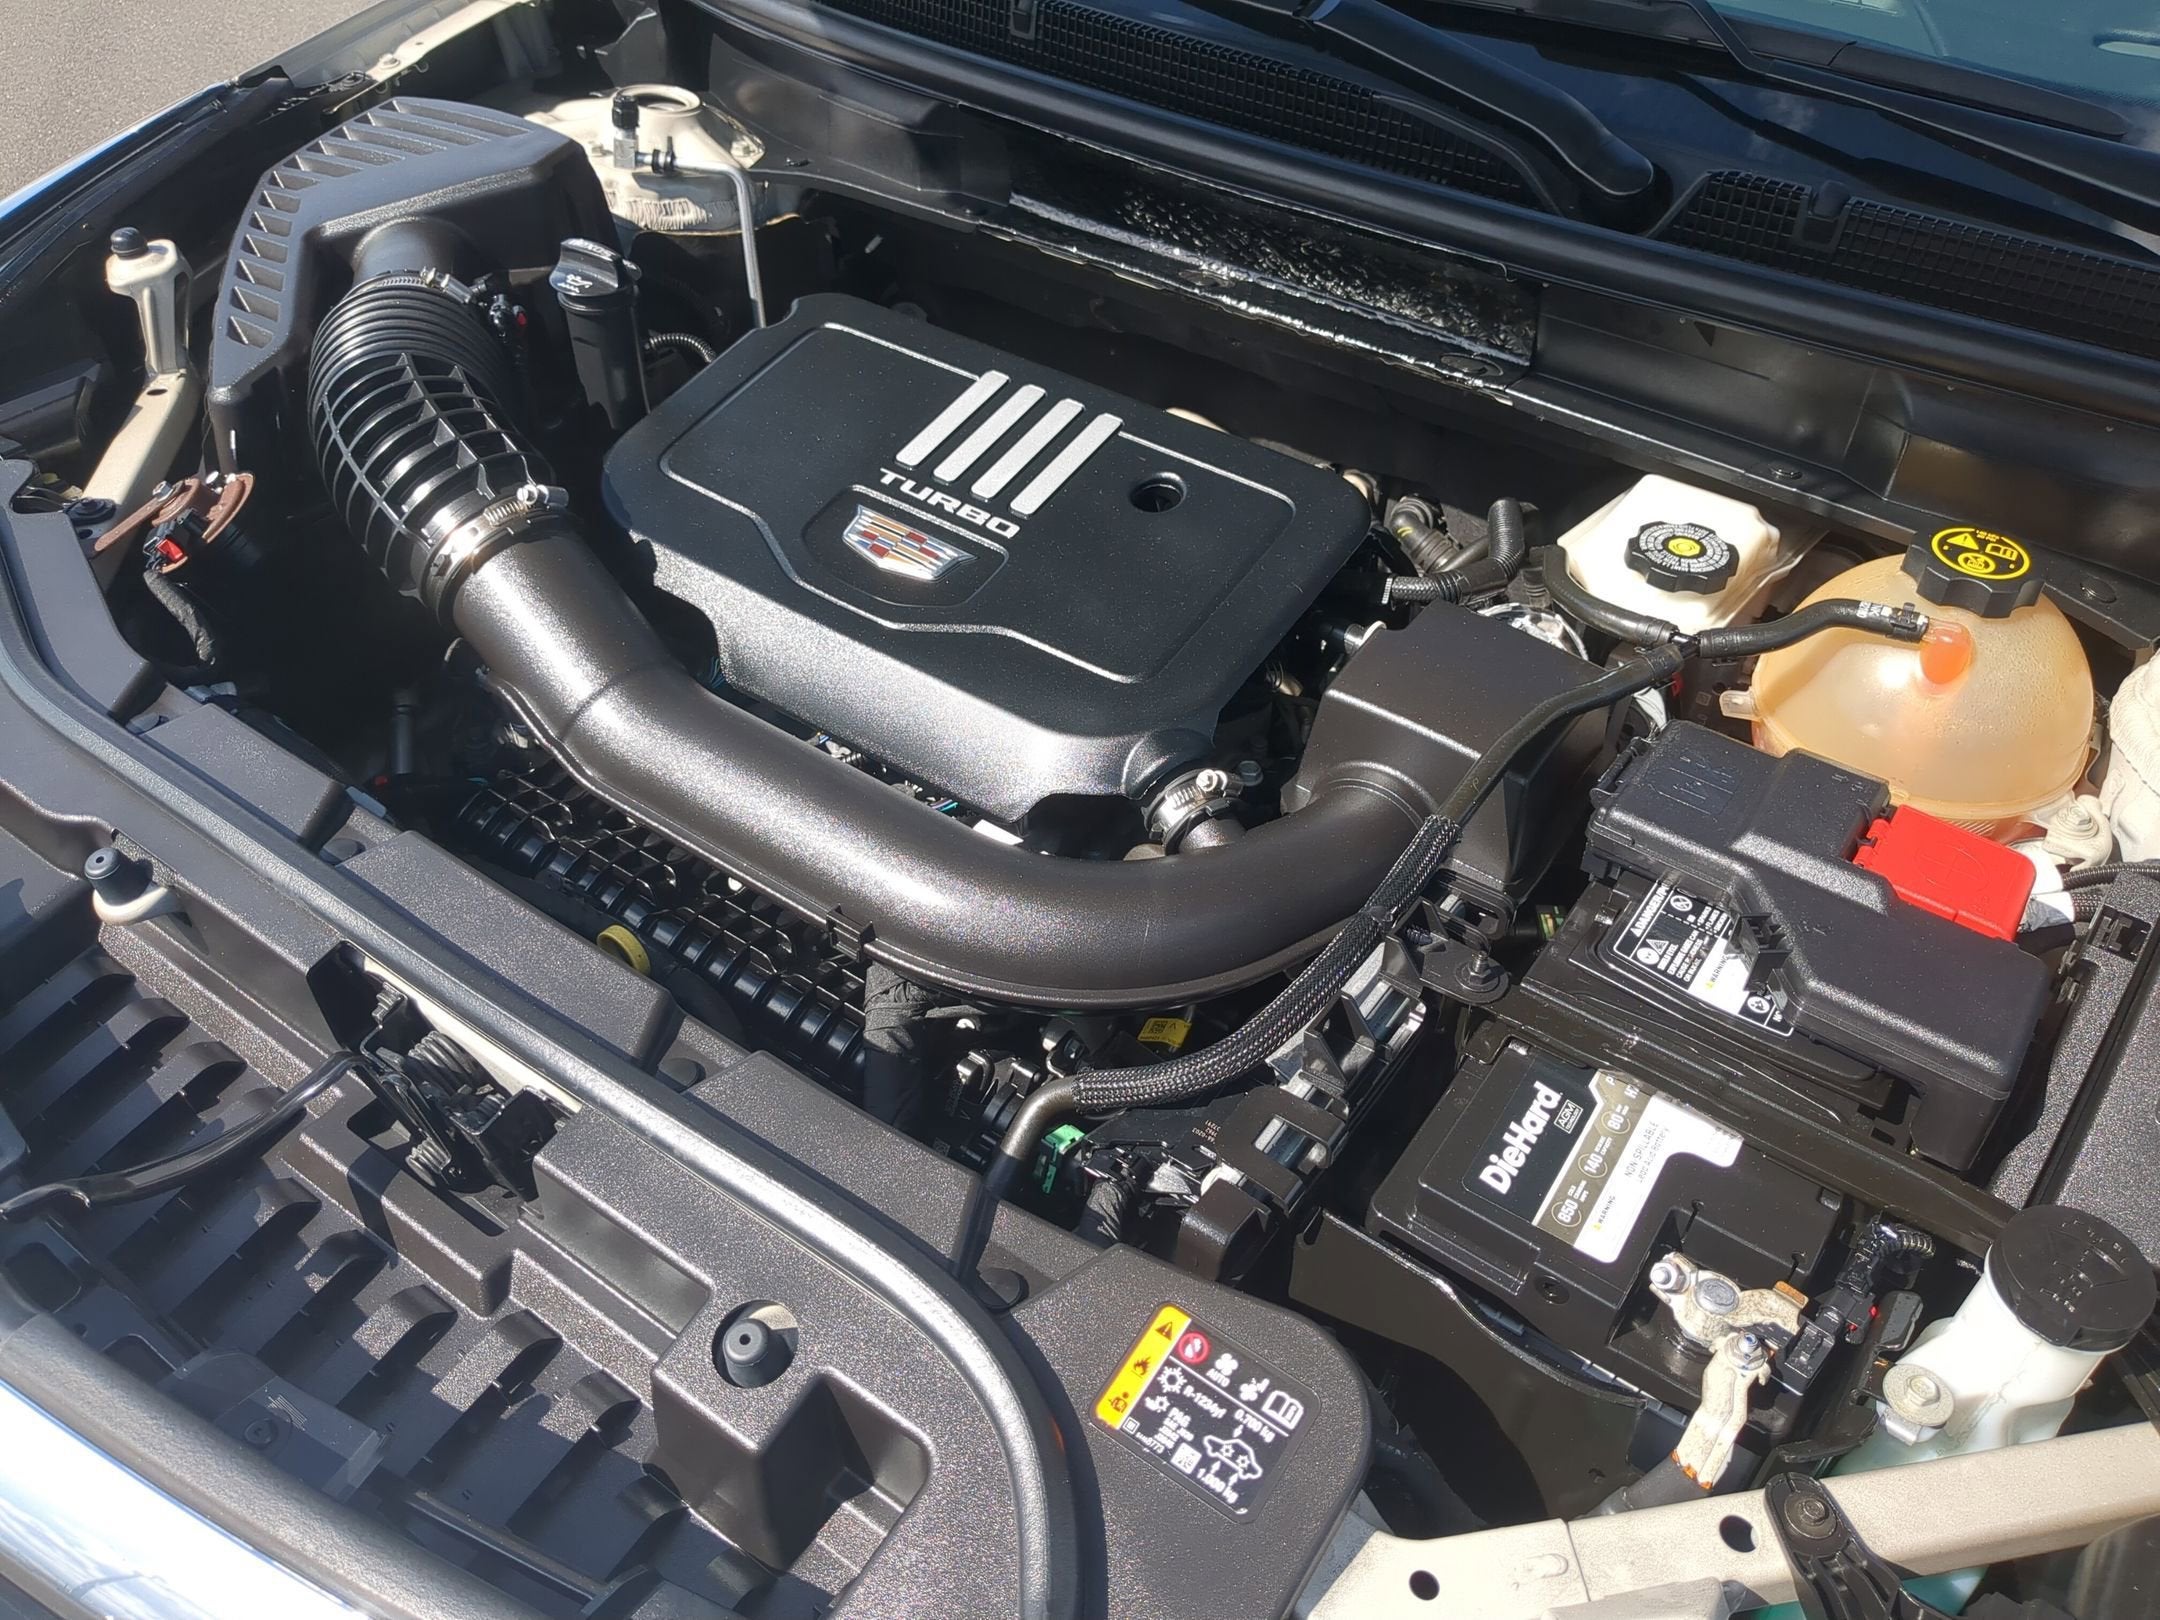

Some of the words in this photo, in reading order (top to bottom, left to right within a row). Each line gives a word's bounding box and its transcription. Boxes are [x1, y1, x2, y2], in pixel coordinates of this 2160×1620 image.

[880, 467, 1021, 539] TURBO
[1710, 953, 1729, 982] WARNING
[1557, 1102, 1576, 1128] AGM
[1606, 1113, 1625, 1131] 80
[1478, 1080, 1562, 1195] DieHard
[1583, 1153, 1603, 1175] 140
[1557, 1198, 1578, 1224] 850
[1599, 1195, 1616, 1225] WARNING
[1205, 1367, 1230, 1388] AUTO
[1180, 1384, 1227, 1421] R-1234yf
[1167, 1406, 1192, 1428] PAG
[1233, 1408, 1264, 1433] 0.700
[1258, 1425, 1276, 1443] kg
[1220, 1485, 1240, 1504] kg
